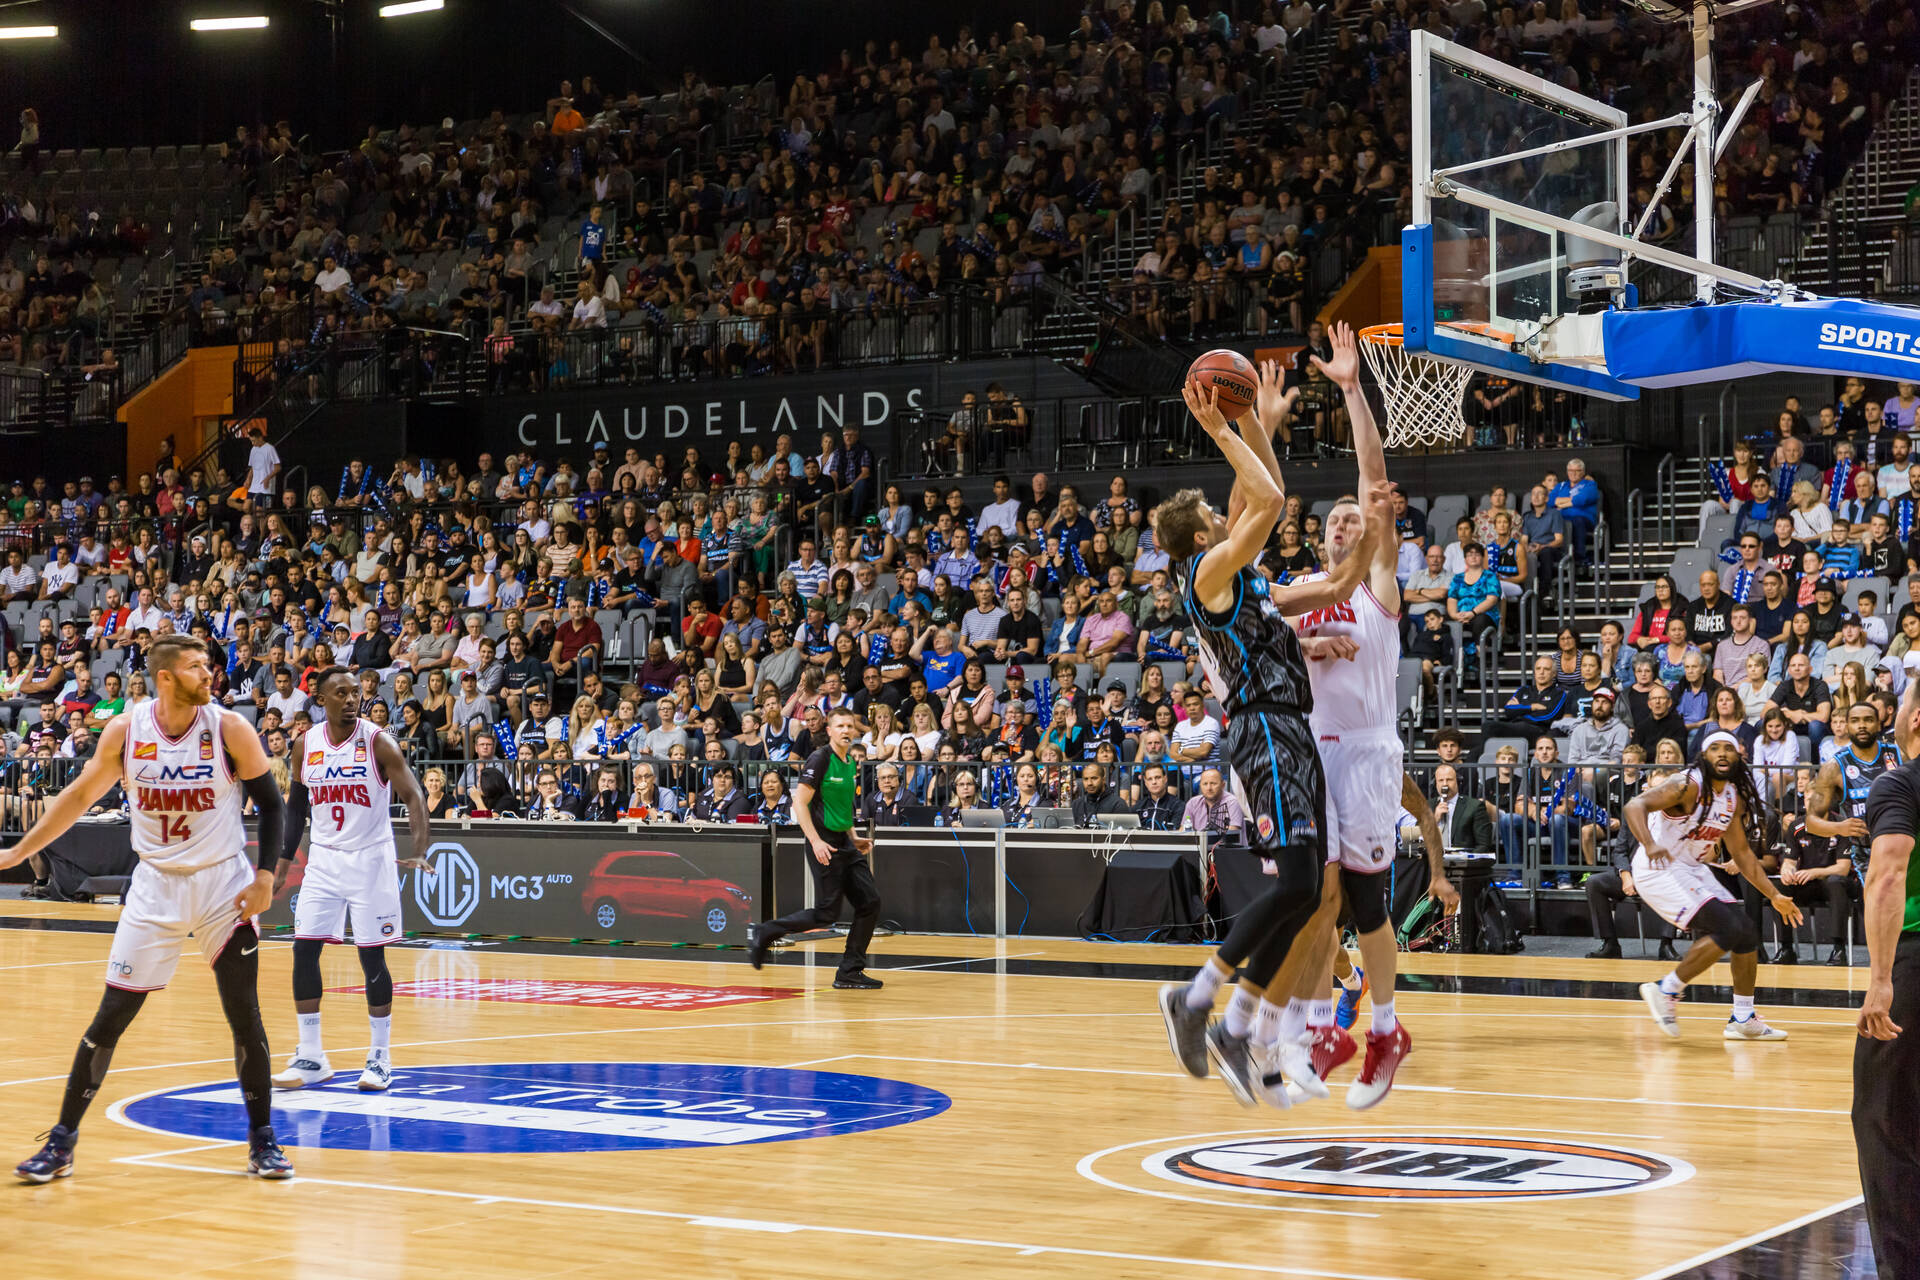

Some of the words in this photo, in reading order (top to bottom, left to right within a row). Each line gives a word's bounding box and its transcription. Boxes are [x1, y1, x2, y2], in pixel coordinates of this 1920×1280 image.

[1212, 375, 1254, 401] Wilson
[518, 388, 923, 446] CLAUDELANDS
[159, 765, 214, 780] MCR
[324, 766, 368, 779] MCR
[137, 787, 216, 812] HAWKS
[310, 784, 372, 808] HAWKS
[159, 814, 191, 844] 14
[331, 805, 345, 832] 9
[422, 852, 473, 917] MG
[490, 875, 544, 900] MG3
[546, 874, 573, 884] AUTO
[489, 1086, 828, 1122] Trobe
[1251, 1145, 1566, 1184] NBL
